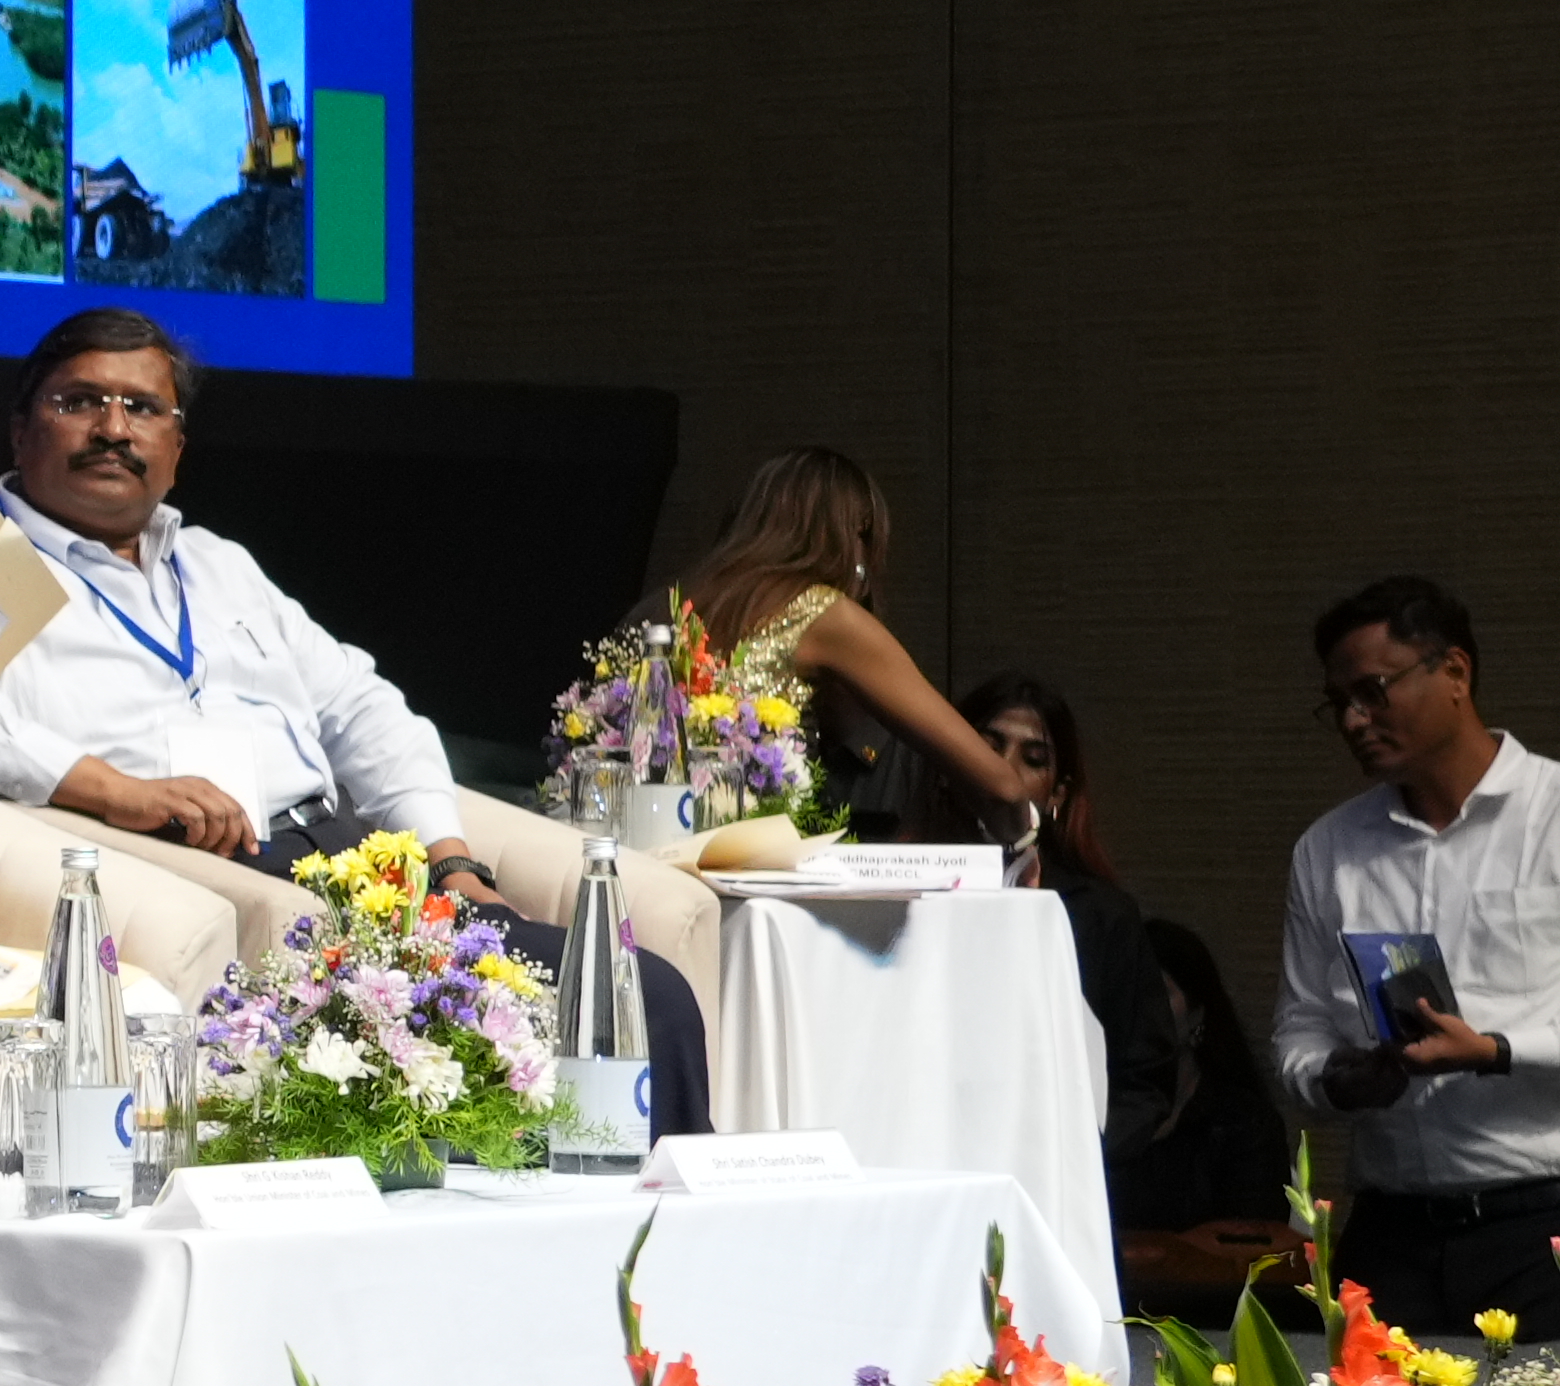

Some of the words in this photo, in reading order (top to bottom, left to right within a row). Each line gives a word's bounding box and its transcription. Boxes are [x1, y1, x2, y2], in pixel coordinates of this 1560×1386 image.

[935, 856, 968, 867] Jyoti
[712, 1157, 730, 1169] Shri
[732, 1156, 757, 1168] Satish
[759, 1155, 795, 1167] Chandra
[797, 1154, 825, 1166] Dubey
[241, 1171, 262, 1183] Shri
[264, 1170, 271, 1181] G
[273, 1170, 301, 1181] Kishan
[303, 1168, 332, 1182] Reddy
